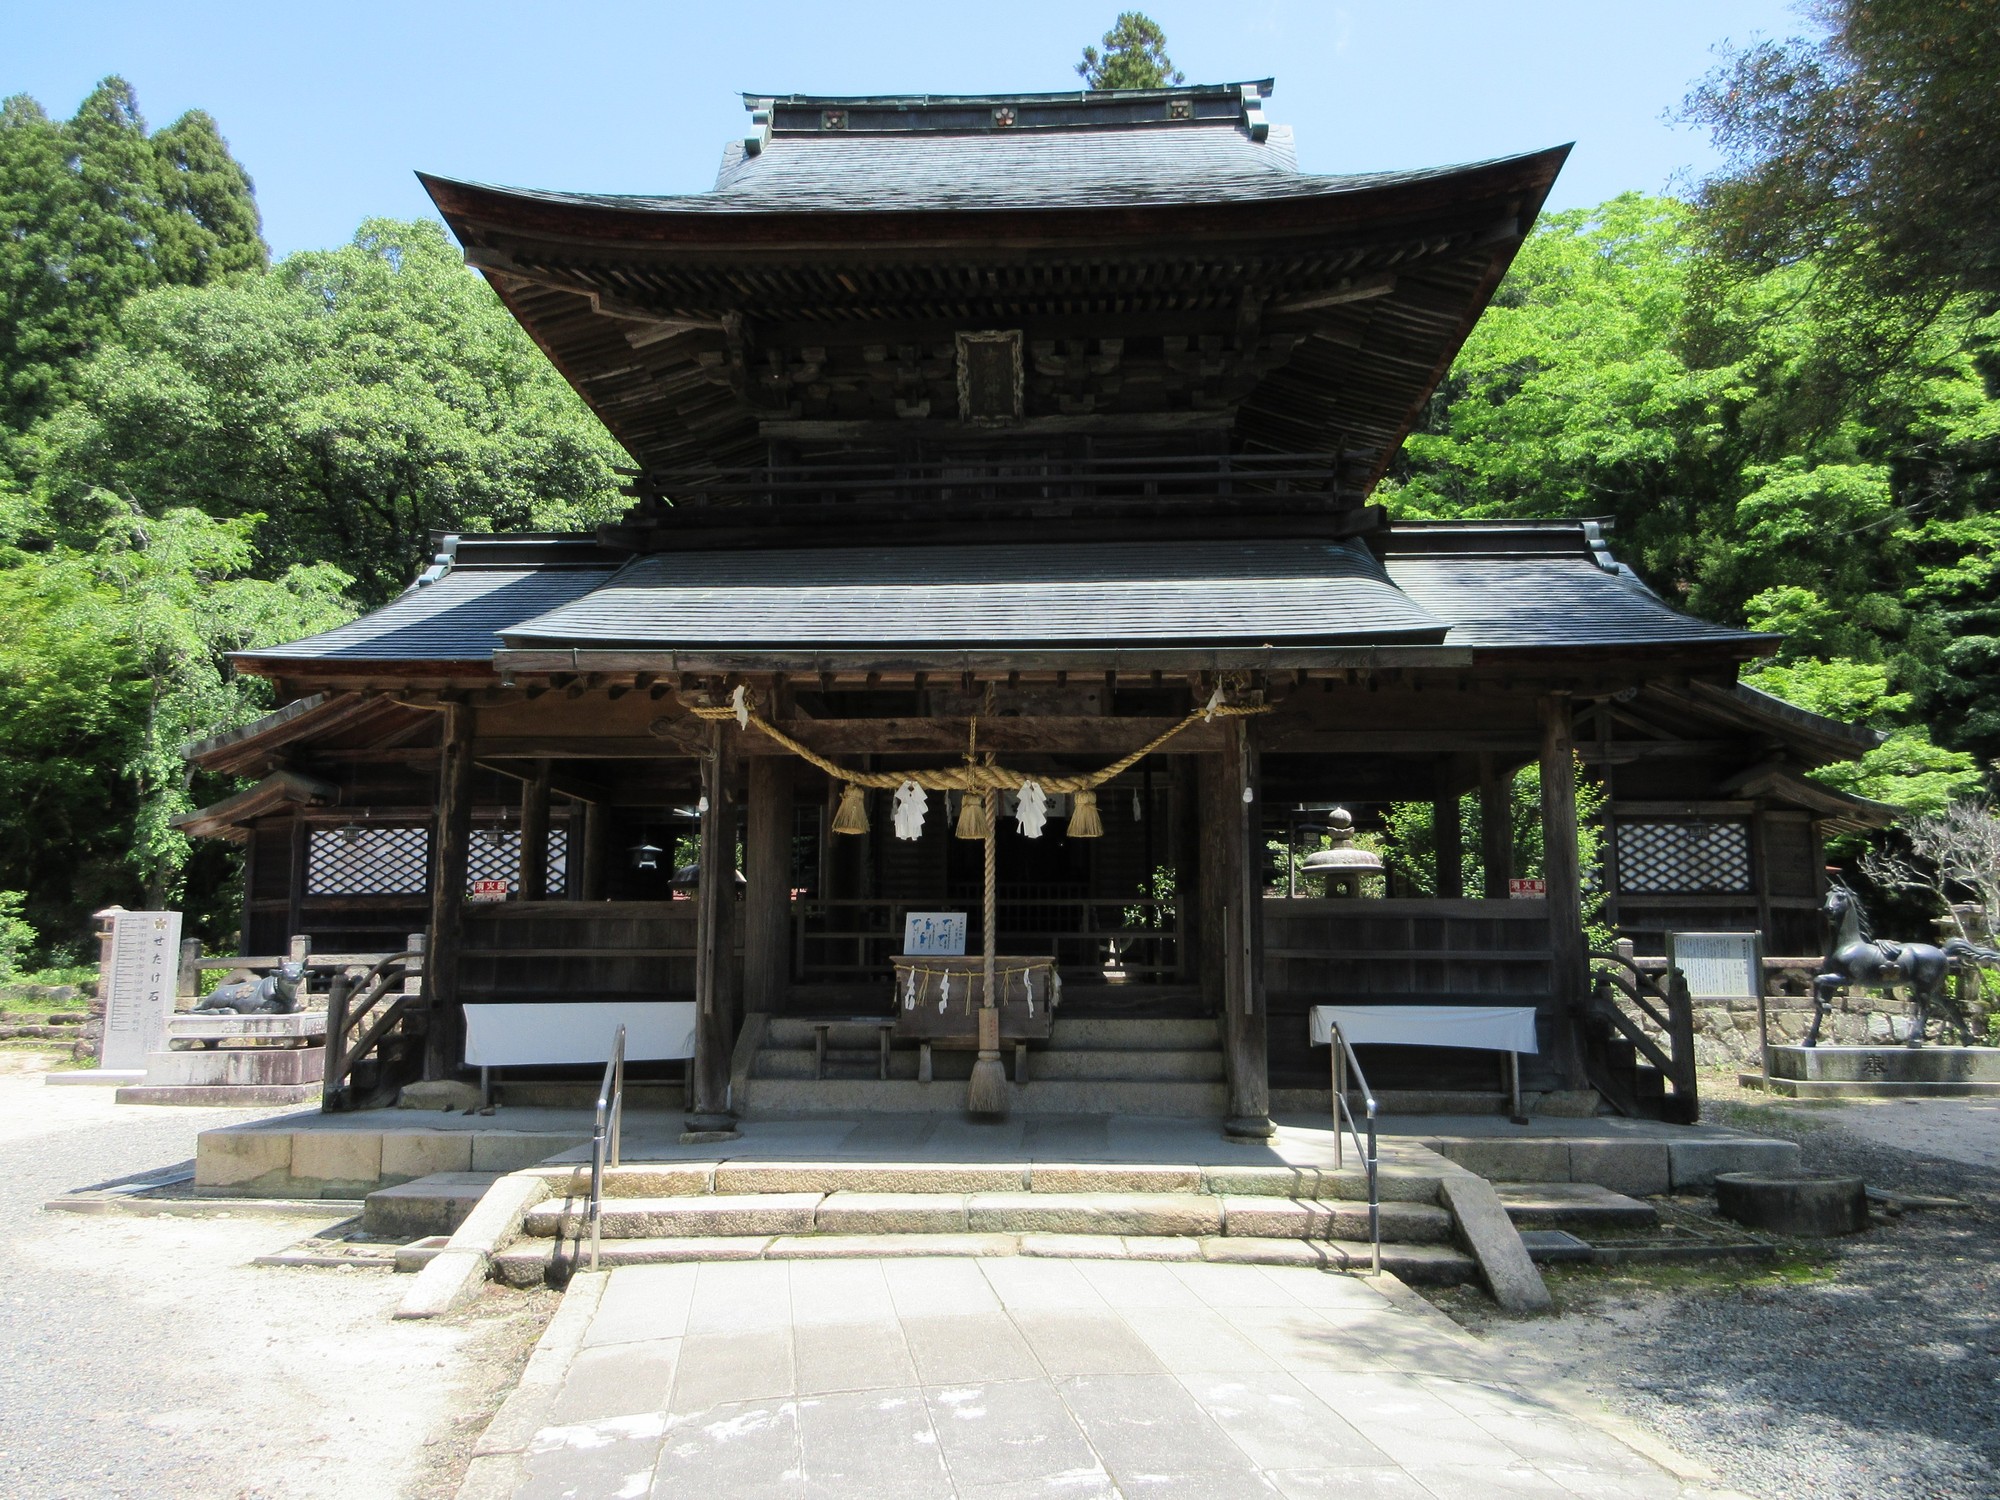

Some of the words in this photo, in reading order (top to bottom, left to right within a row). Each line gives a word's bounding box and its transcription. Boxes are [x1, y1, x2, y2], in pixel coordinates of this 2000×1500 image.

[476, 881, 506, 890] 消火器
[148, 936, 164, 1002] せたけ石
[1861, 1053, 1889, 1076] 奉
